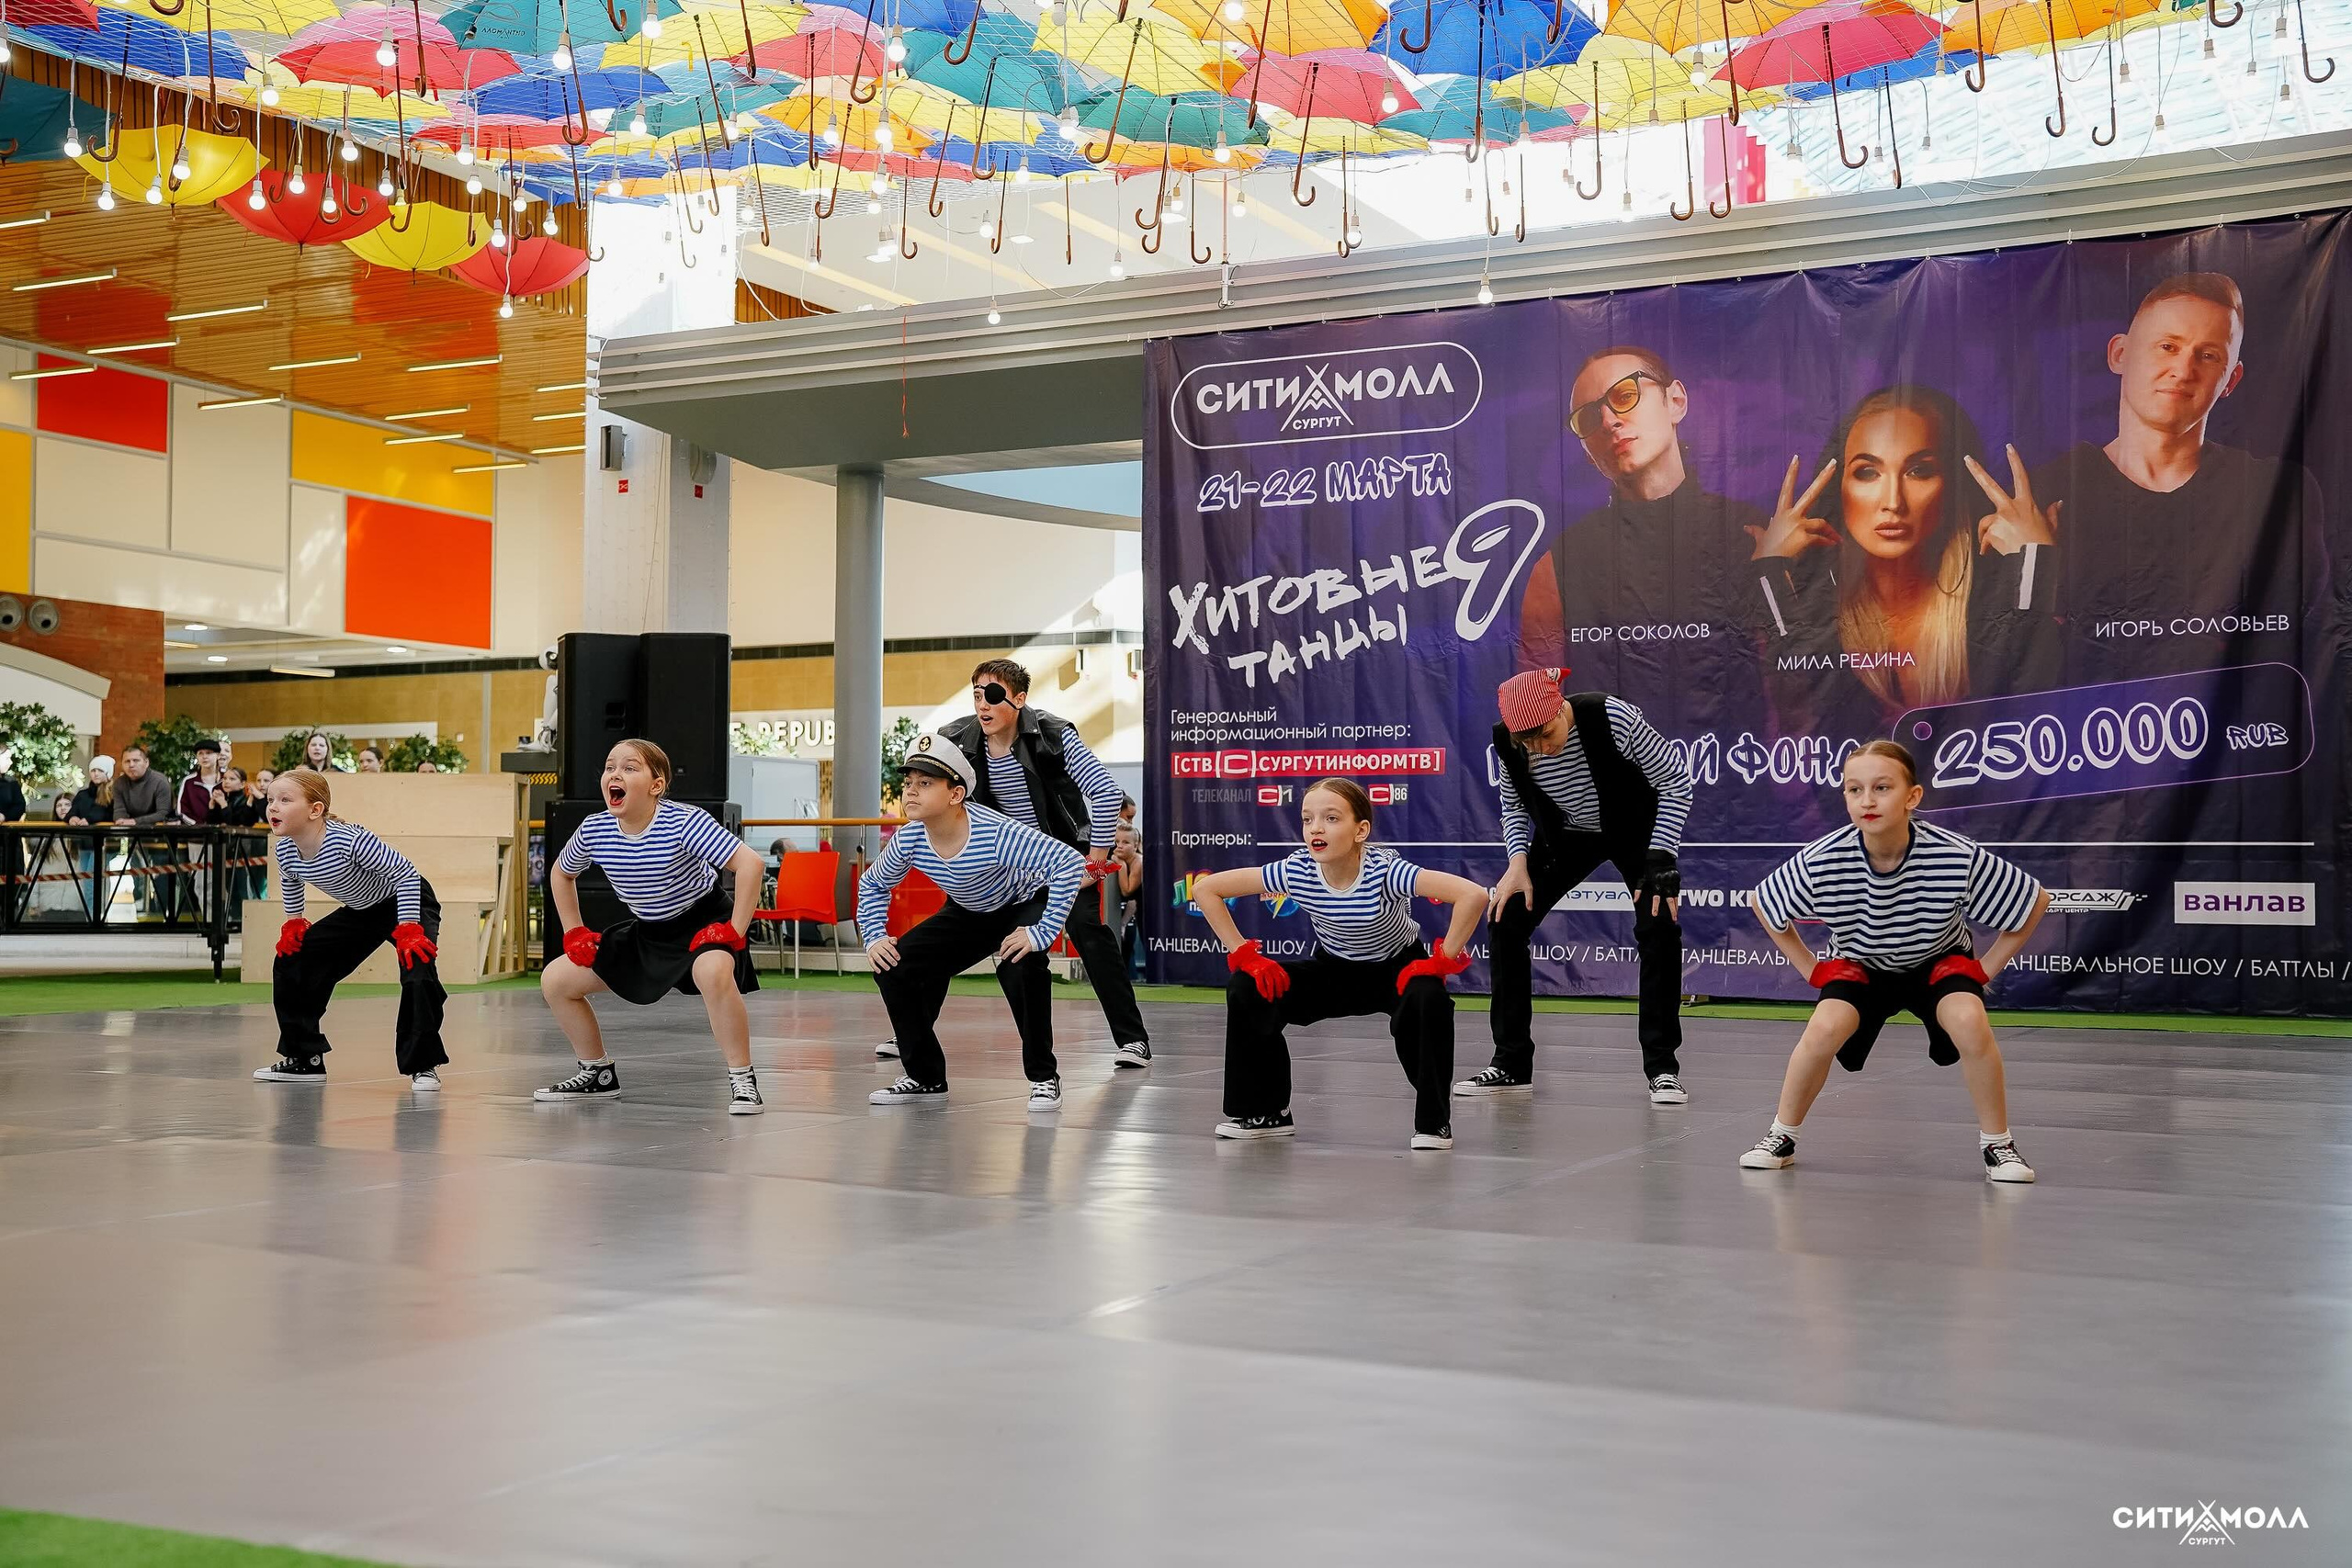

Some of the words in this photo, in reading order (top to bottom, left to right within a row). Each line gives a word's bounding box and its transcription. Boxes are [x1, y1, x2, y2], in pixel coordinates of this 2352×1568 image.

[1196, 375, 1300, 414] СИТИ
[1334, 362, 1455, 401] МОЛЛ
[1292, 414, 1342, 431] СУРГУТ
[1196, 467, 1317, 513] 21-22
[1325, 452, 1452, 502] МАРТА
[1570, 626, 1613, 643] ЕГОР
[1617, 623, 1711, 641] СОКОЛОВ
[2095, 619, 2165, 638] ИГОРЬ
[2169, 614, 2290, 636] СОЛОВЬЕВ
[1227, 604, 1408, 689] ТАНЦЫ
[1776, 654, 1834, 671] МИЛА
[1838, 651, 1917, 671] РЕДИНА
[1170, 706, 1277, 726] Генеральный
[1170, 723, 1327, 744] информационный
[1331, 722, 1412, 740] партнер:
[1931, 695, 2210, 789] 250.000
[2225, 721, 2290, 750] RUB
[1192, 788, 1251, 803] ТЕЛЕКАНАЛ
[1171, 830, 1252, 848] Партнеры:
[2046, 892, 2117, 902] ОРСАЖ
[2184, 894, 2306, 912] ванлав
[1148, 937, 1263, 954] ТАНЦЕВАЛЬ
[1266, 940, 1306, 955] ШОУ
[1532, 945, 1577, 961] ШОУ
[1595, 946, 1640, 963] БАТТ
[1681, 948, 1826, 967] ТАНЦЕВАЛЬЕ
[2004, 954, 2164, 976] АНЦЕВАЛЬНОЕ
[2171, 957, 2227, 976] ШОУ
[2251, 959, 2335, 979] БАТТЛЫ
